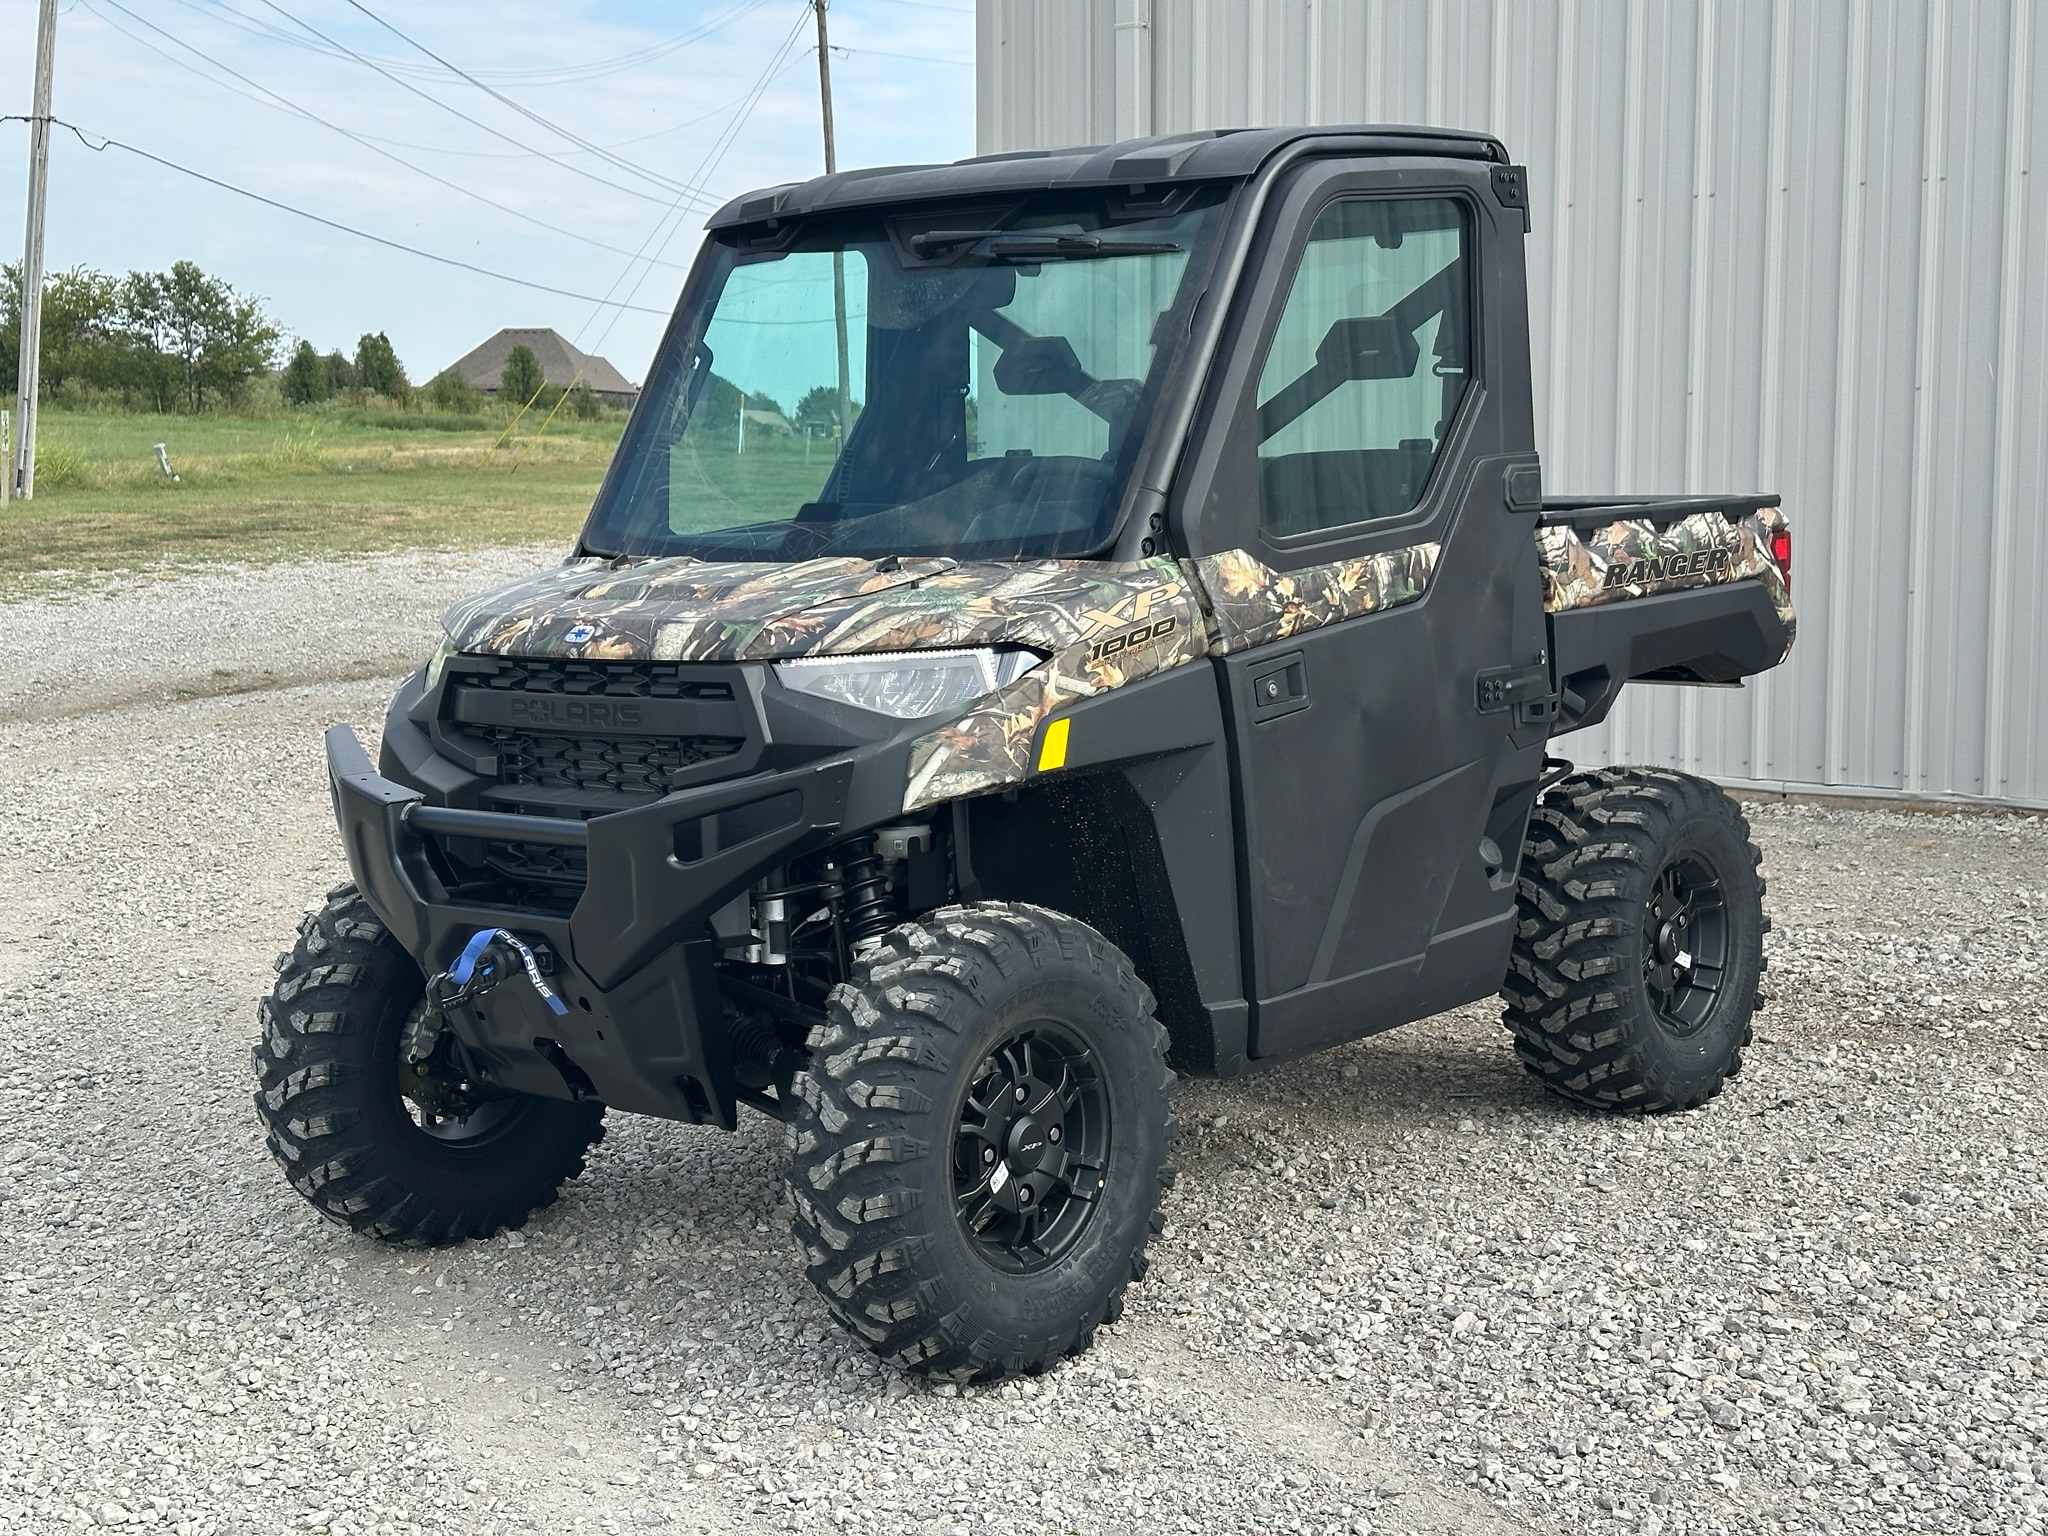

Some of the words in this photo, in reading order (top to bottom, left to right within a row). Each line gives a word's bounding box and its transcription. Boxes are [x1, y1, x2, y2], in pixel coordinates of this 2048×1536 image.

[1602, 547, 1728, 590] RANGER
[1073, 580, 1183, 645] XP
[1091, 615, 1178, 662] 1000
[510, 698, 643, 729] POLARIS
[496, 929, 554, 998] POLARIS
[1021, 1141, 1042, 1151] XP
